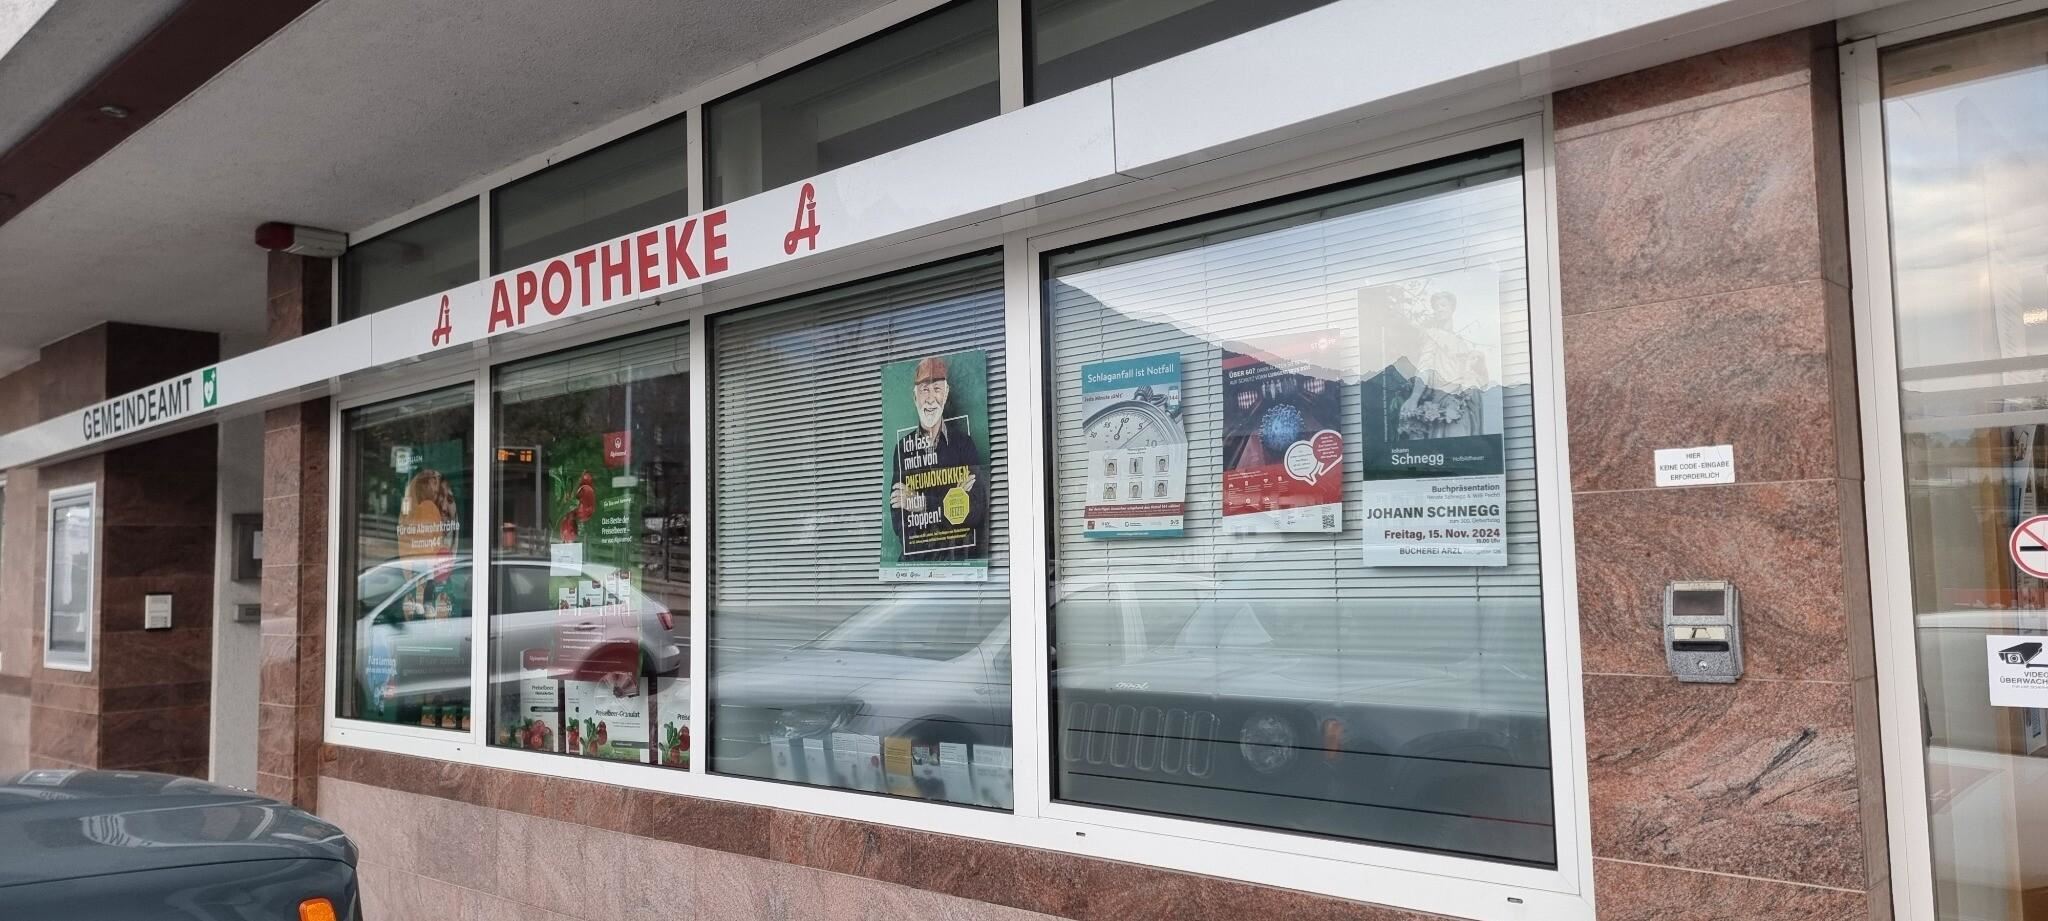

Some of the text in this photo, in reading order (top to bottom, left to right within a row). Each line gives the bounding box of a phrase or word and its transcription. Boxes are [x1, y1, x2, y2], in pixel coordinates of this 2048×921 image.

[487, 209, 728, 334] APOTHEKE
[1087, 363, 1174, 384] Schlaganfall ist Notfall
[83, 377, 192, 441] GEMEINDEAMT
[903, 434, 914, 453] Ich
[904, 451, 938, 470] mich von
[1391, 453, 1444, 466] Schnegg
[905, 465, 970, 492] PNEUMOKOKKEN
[1670, 472, 1720, 481] ERFORDERLICH
[1431, 484, 1500, 494] Buchpräsentation
[907, 507, 942, 529] stoppen!
[1367, 504, 1500, 520] JOHANN SCHNEGG
[1384, 528, 1501, 541] Freitag, 15. Nov. 2024
[1399, 546, 1440, 555] BÜCHEREI
[1441, 547, 1463, 555] ARZL
